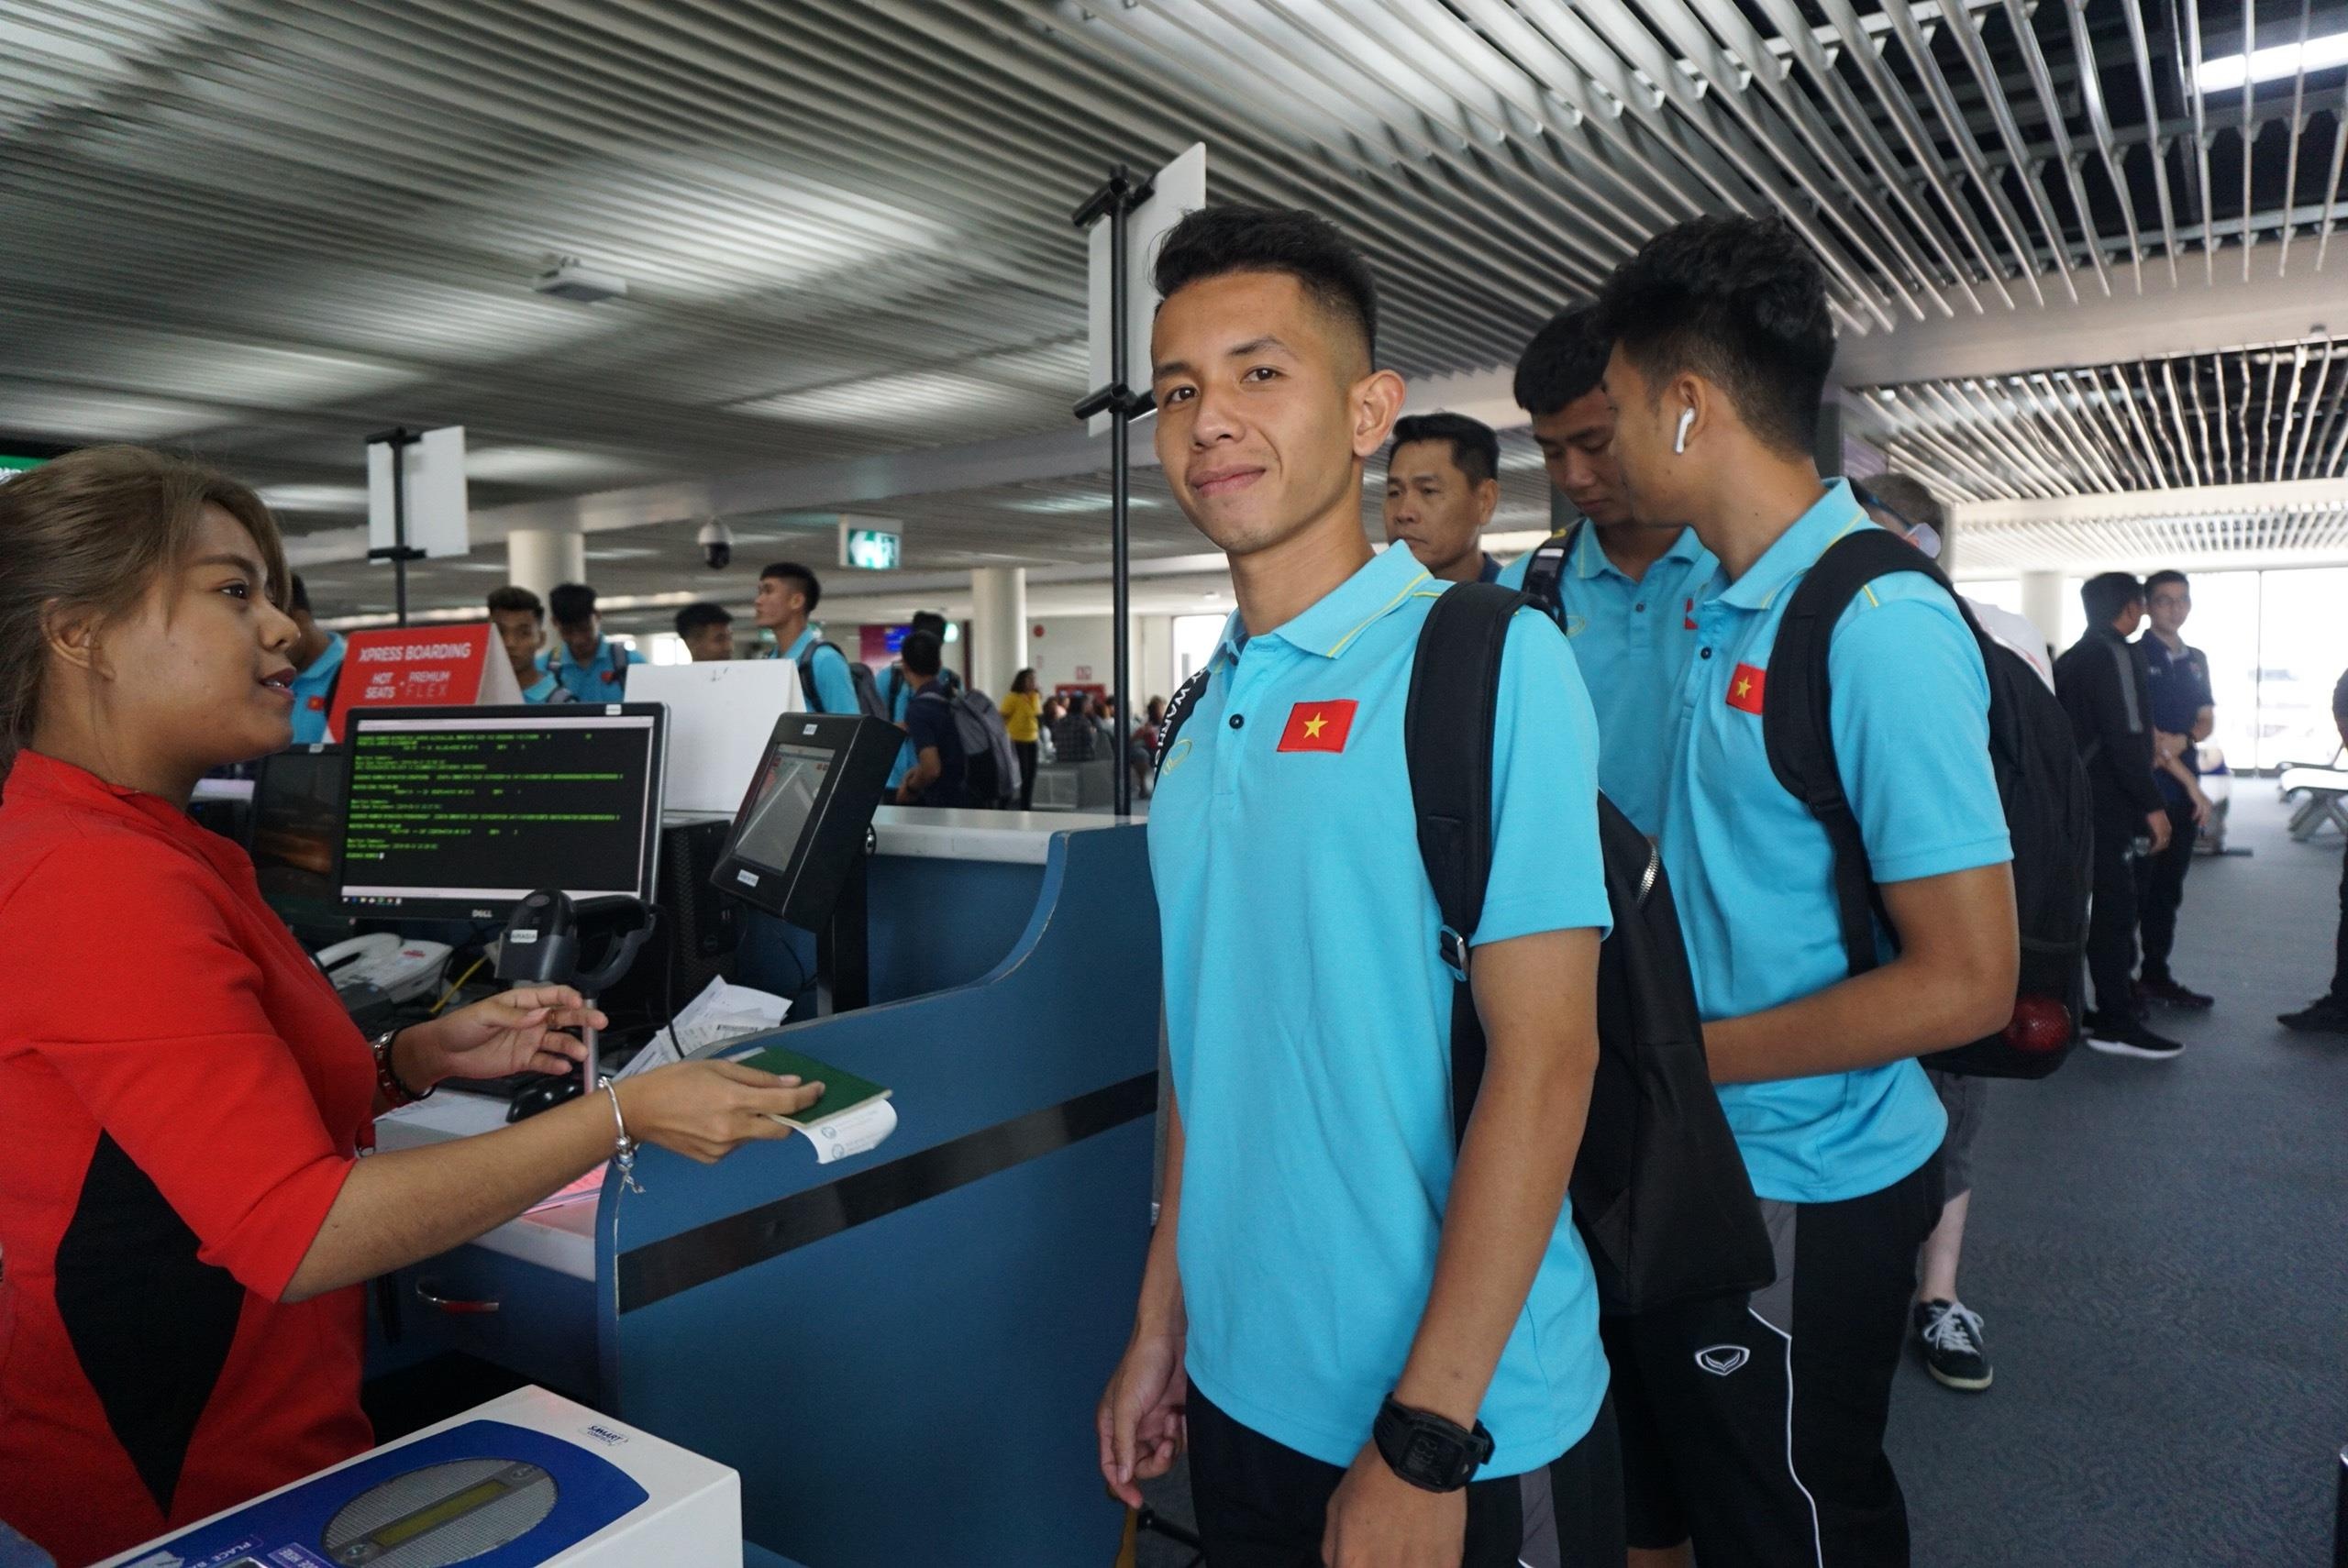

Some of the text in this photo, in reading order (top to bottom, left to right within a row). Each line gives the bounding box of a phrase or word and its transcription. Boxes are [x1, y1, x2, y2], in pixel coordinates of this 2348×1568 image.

[359, 643, 471, 662] XPRESS BOARDING
[372, 672, 394, 684] HOT
[409, 671, 450, 683] PREMIUM
[364, 686, 395, 700] SEATS
[404, 683, 448, 698] FLEX
